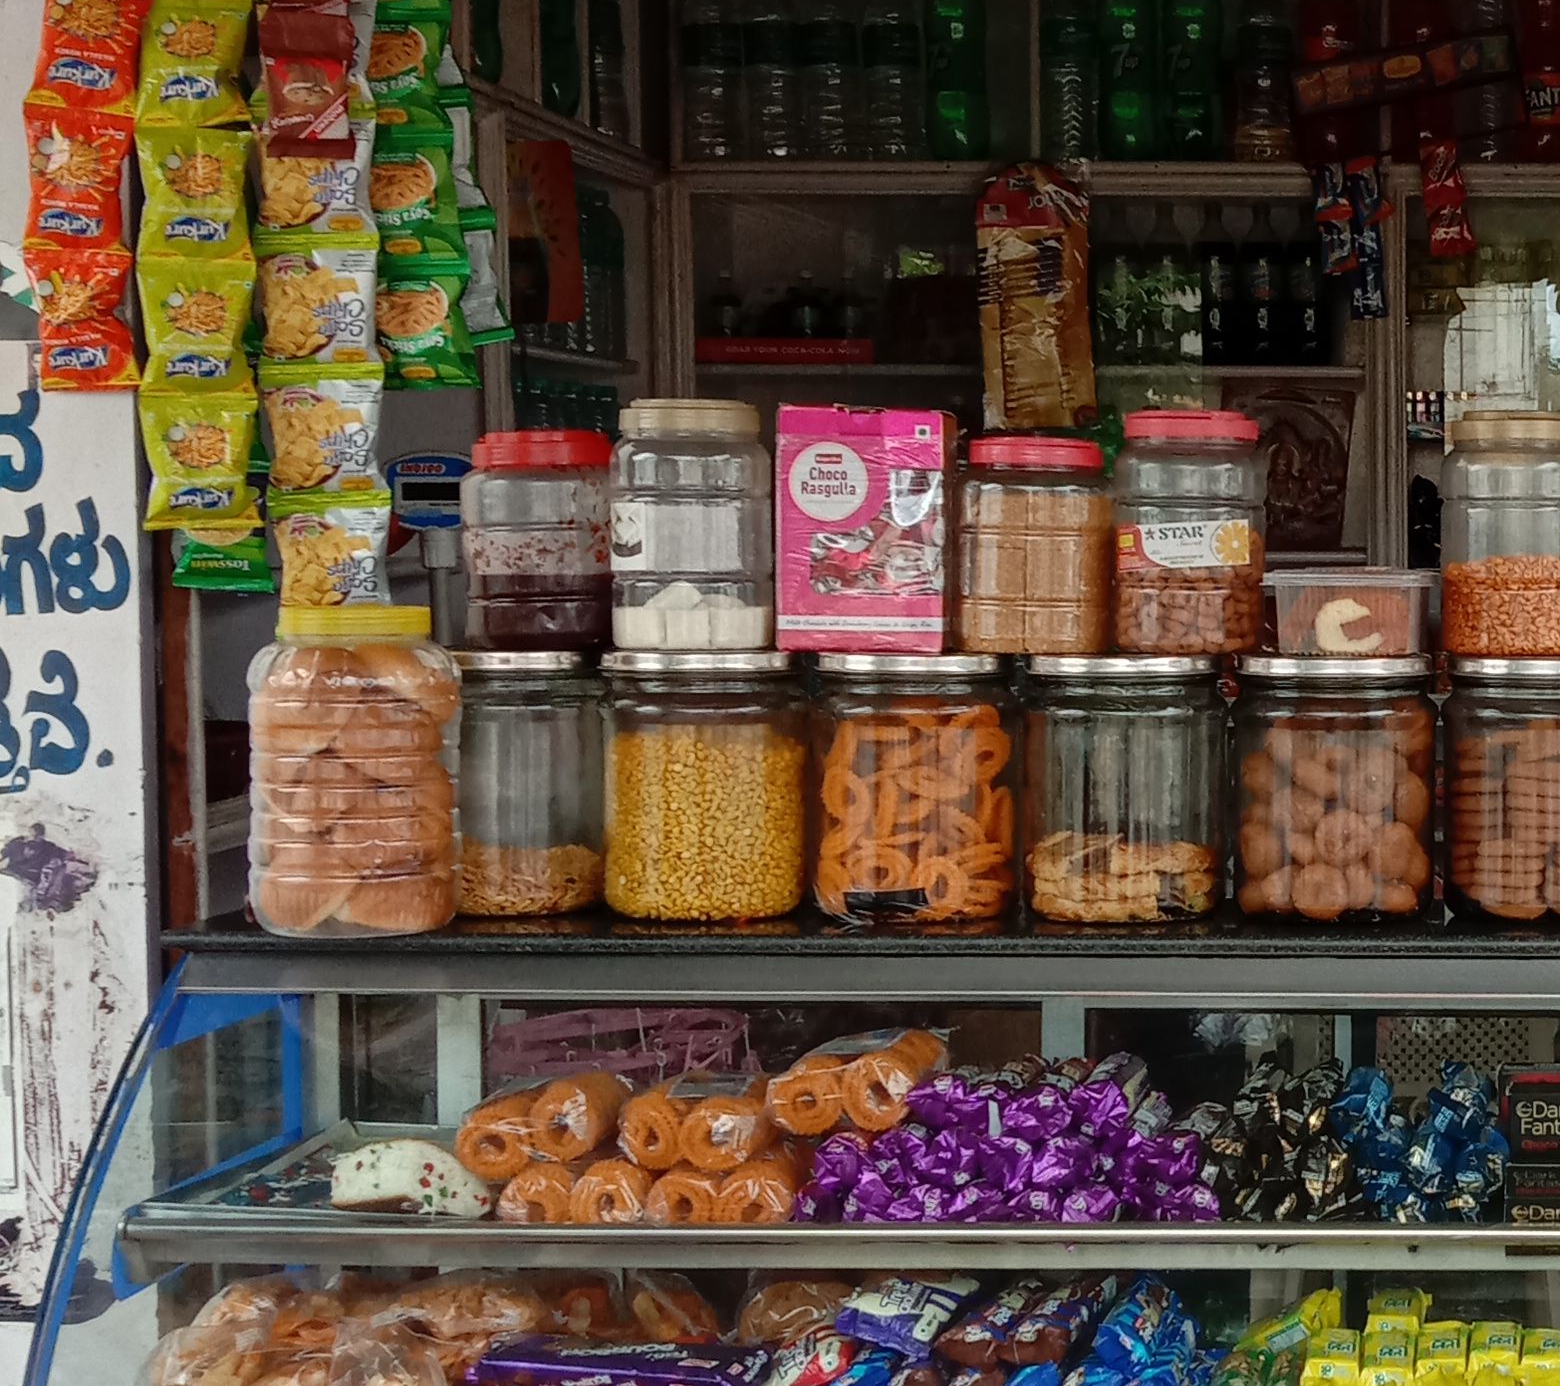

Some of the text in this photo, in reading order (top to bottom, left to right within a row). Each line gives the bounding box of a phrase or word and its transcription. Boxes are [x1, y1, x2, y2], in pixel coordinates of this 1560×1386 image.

[809, 467, 848, 481] Choco
[800, 481, 857, 499] Rasgulla
[1158, 525, 1204, 541] STAR
